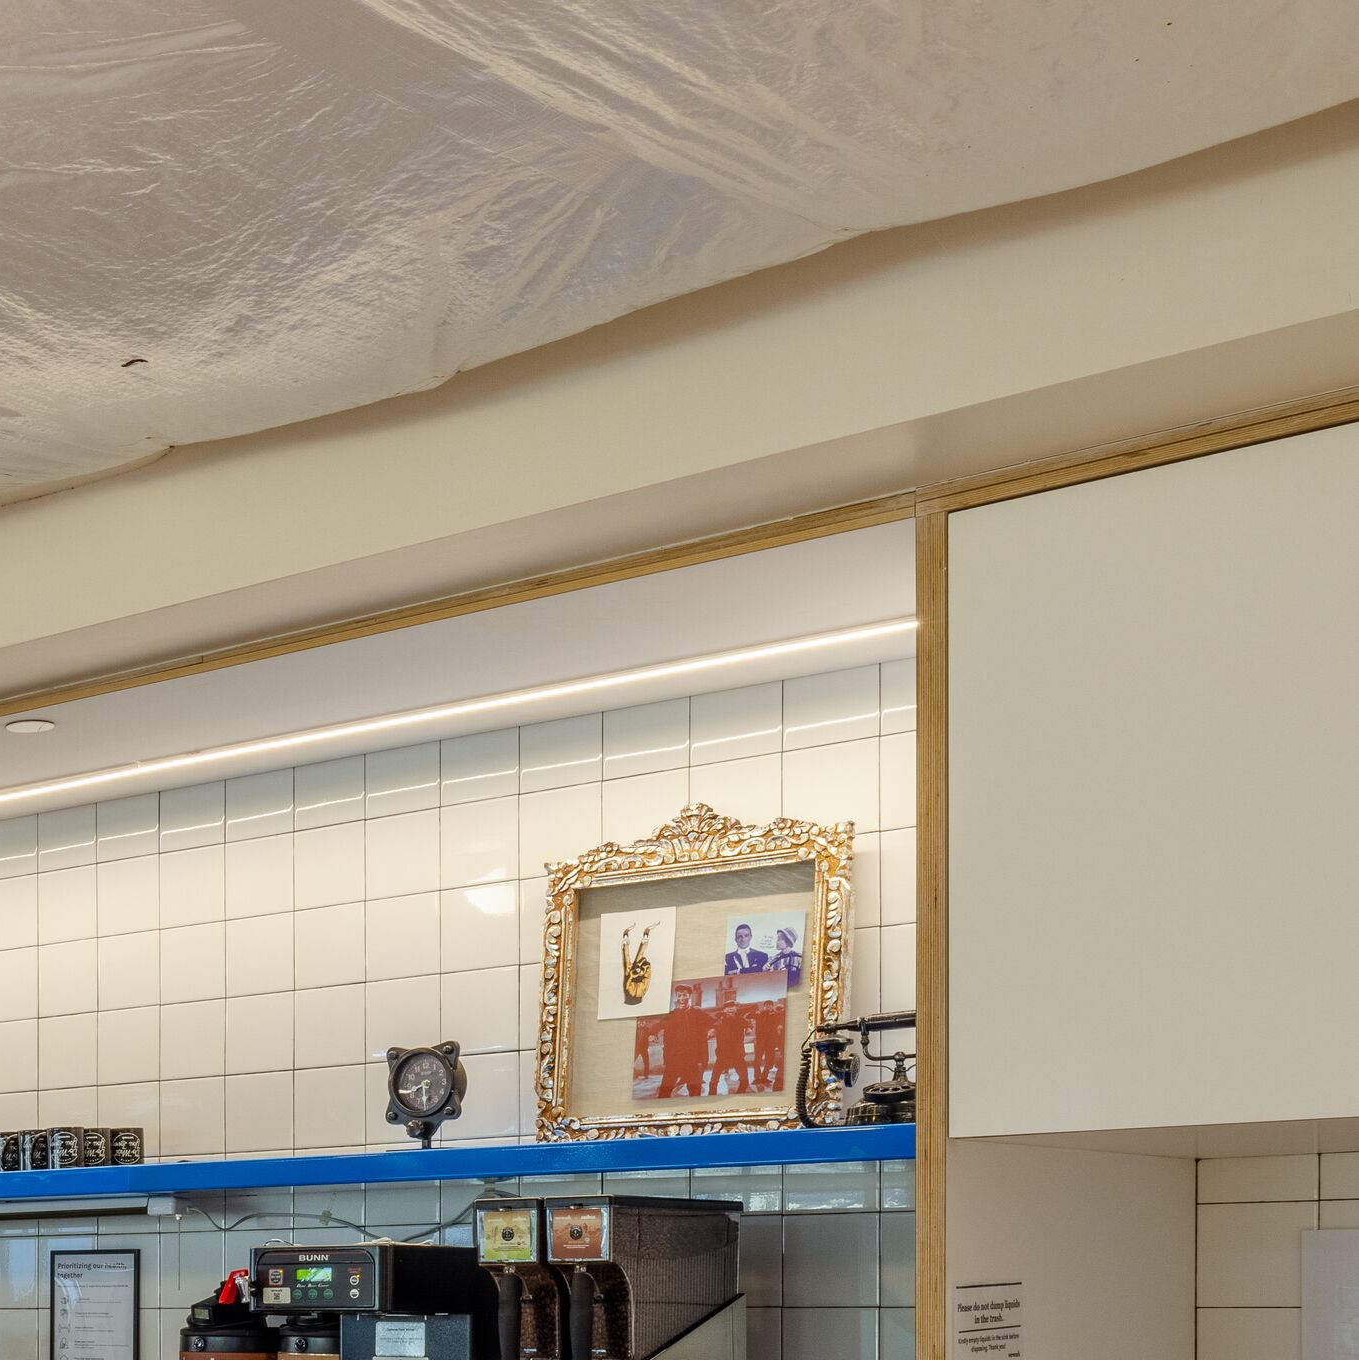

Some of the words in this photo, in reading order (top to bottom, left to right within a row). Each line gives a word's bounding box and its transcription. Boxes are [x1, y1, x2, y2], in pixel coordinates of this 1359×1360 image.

[298, 1254, 329, 1262] BUNN
[57, 1262, 91, 1271] Prioritizing
[957, 1303, 972, 1313] Please
[973, 1301, 980, 1311] do
[980, 1302, 989, 1311] not
[990, 1300, 1004, 1311] dump
[1004, 1298, 1020, 1311] liquids
[974, 1314, 980, 1324] in
[980, 1314, 989, 1323] the
